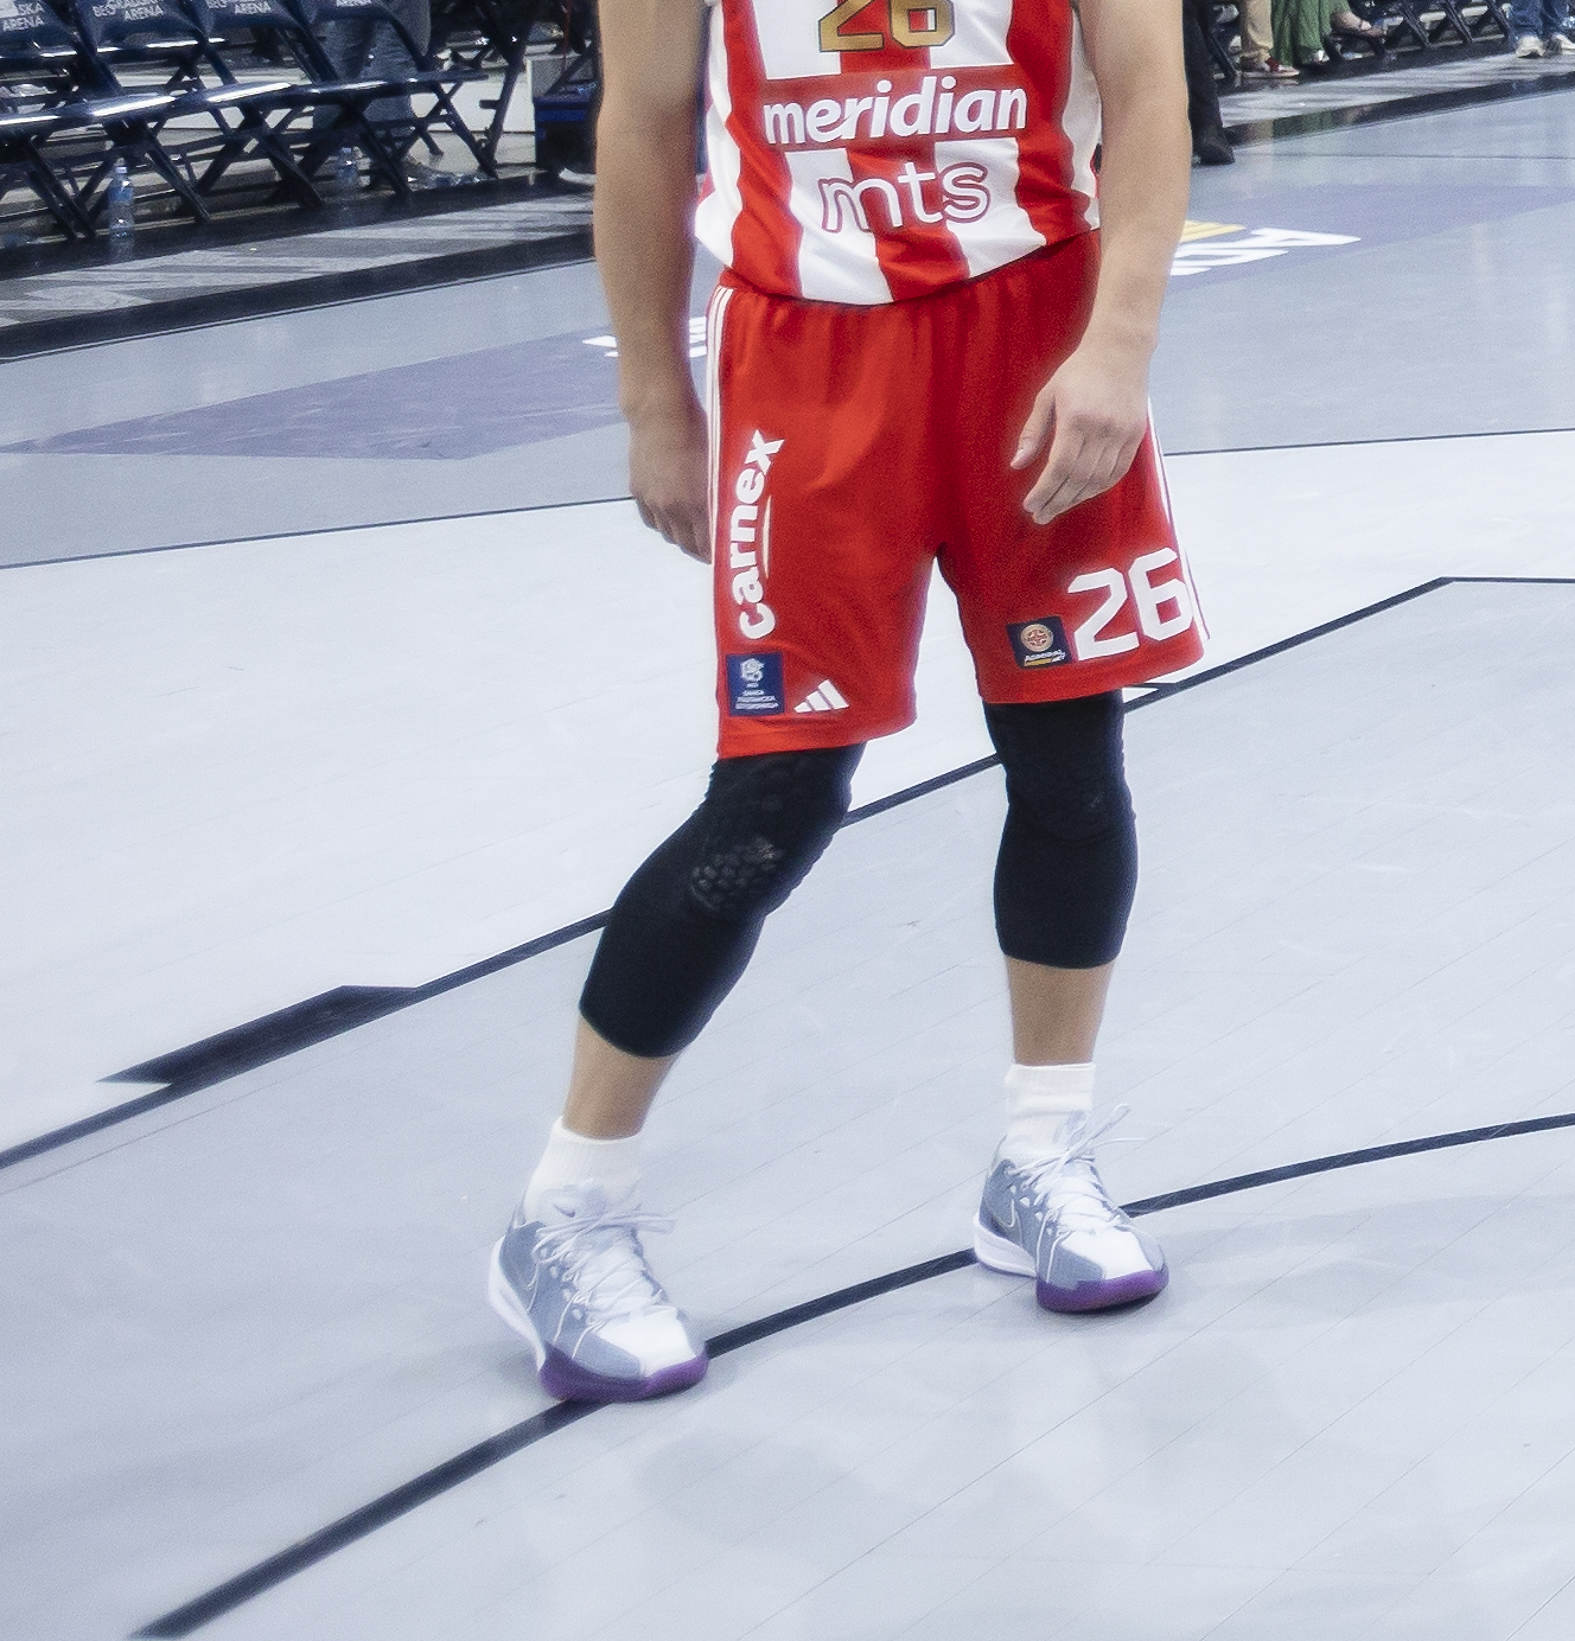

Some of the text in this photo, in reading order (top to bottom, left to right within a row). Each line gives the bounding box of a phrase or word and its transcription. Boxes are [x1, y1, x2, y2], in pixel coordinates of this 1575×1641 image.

[2, 15, 45, 33] ARENA
[124, 4, 165, 22] ARENA
[762, 75, 1027, 145] meridian
[816, 161, 992, 234] mts
[729, 428, 785, 640] carnex
[1067, 546, 1195, 661] 26
